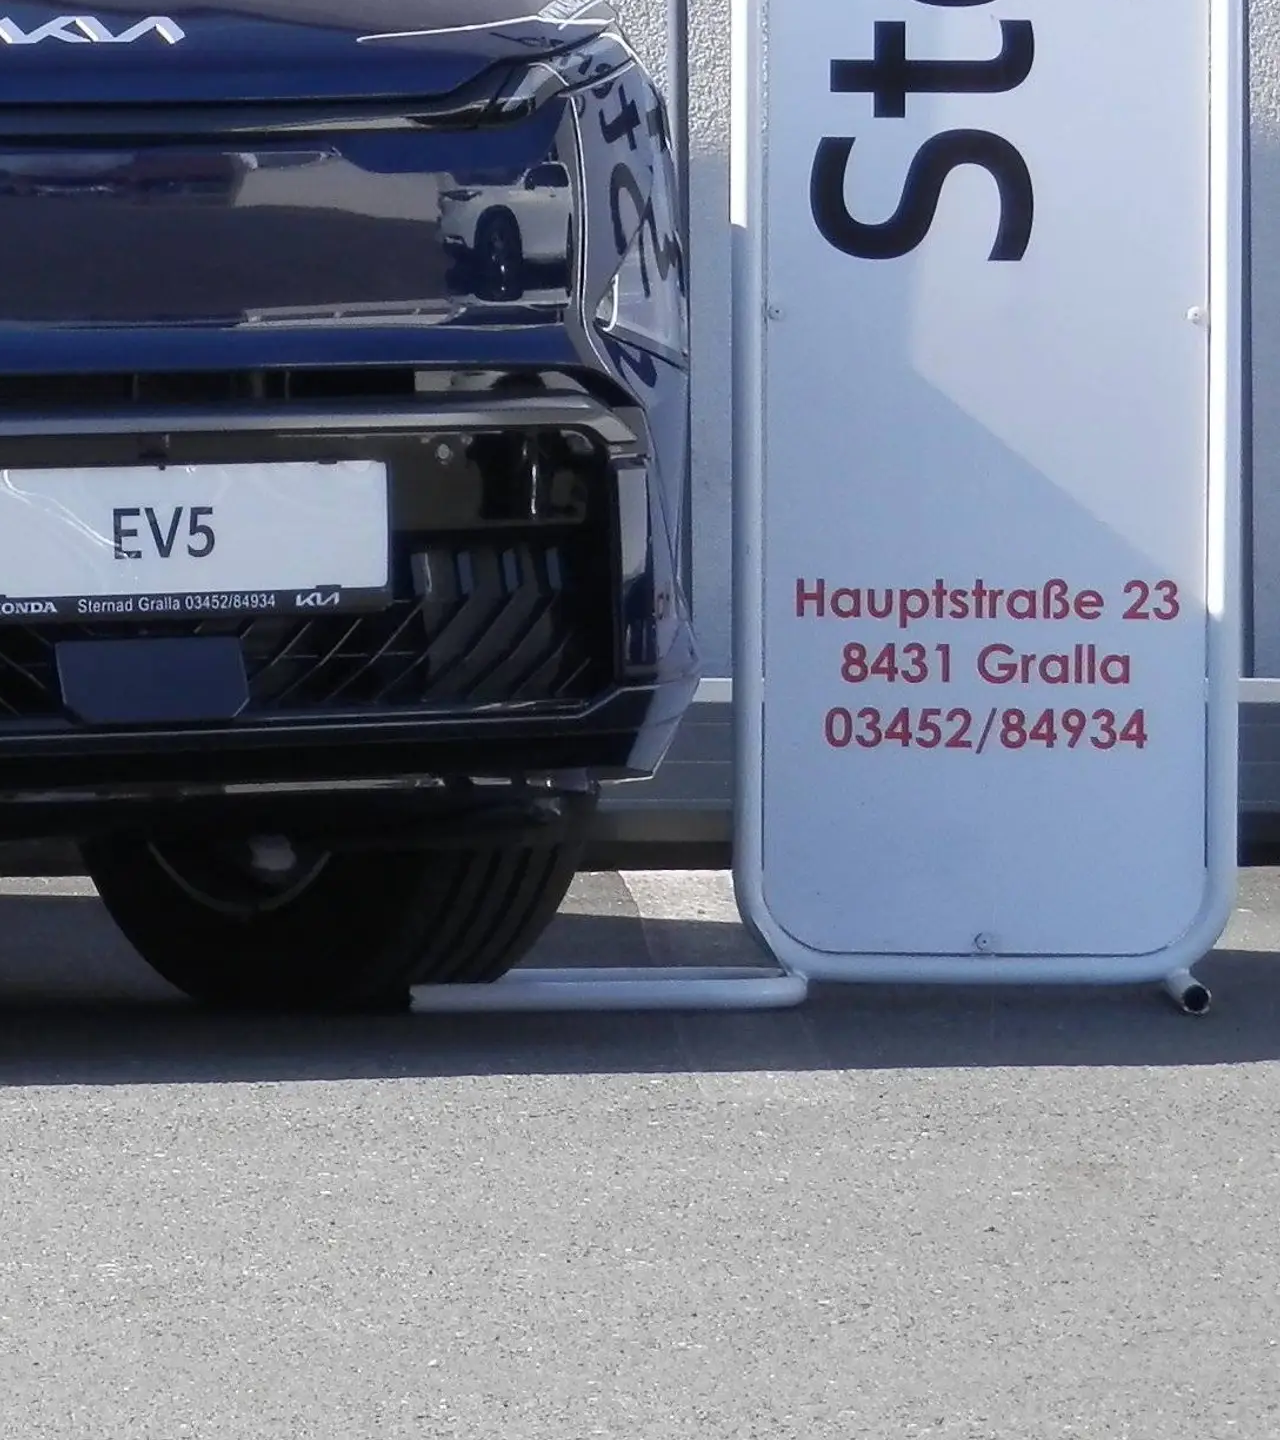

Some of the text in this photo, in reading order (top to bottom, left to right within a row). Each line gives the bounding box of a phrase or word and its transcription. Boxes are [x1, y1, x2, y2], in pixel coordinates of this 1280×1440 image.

[112, 506, 216, 560] EV5
[78, 594, 276, 613] Sternad Gralla 03452/84934
[795, 578, 1180, 627] Hauptstraße 23
[841, 642, 1131, 684] 8431 Gralla
[825, 707, 1148, 754] 03452/84934
